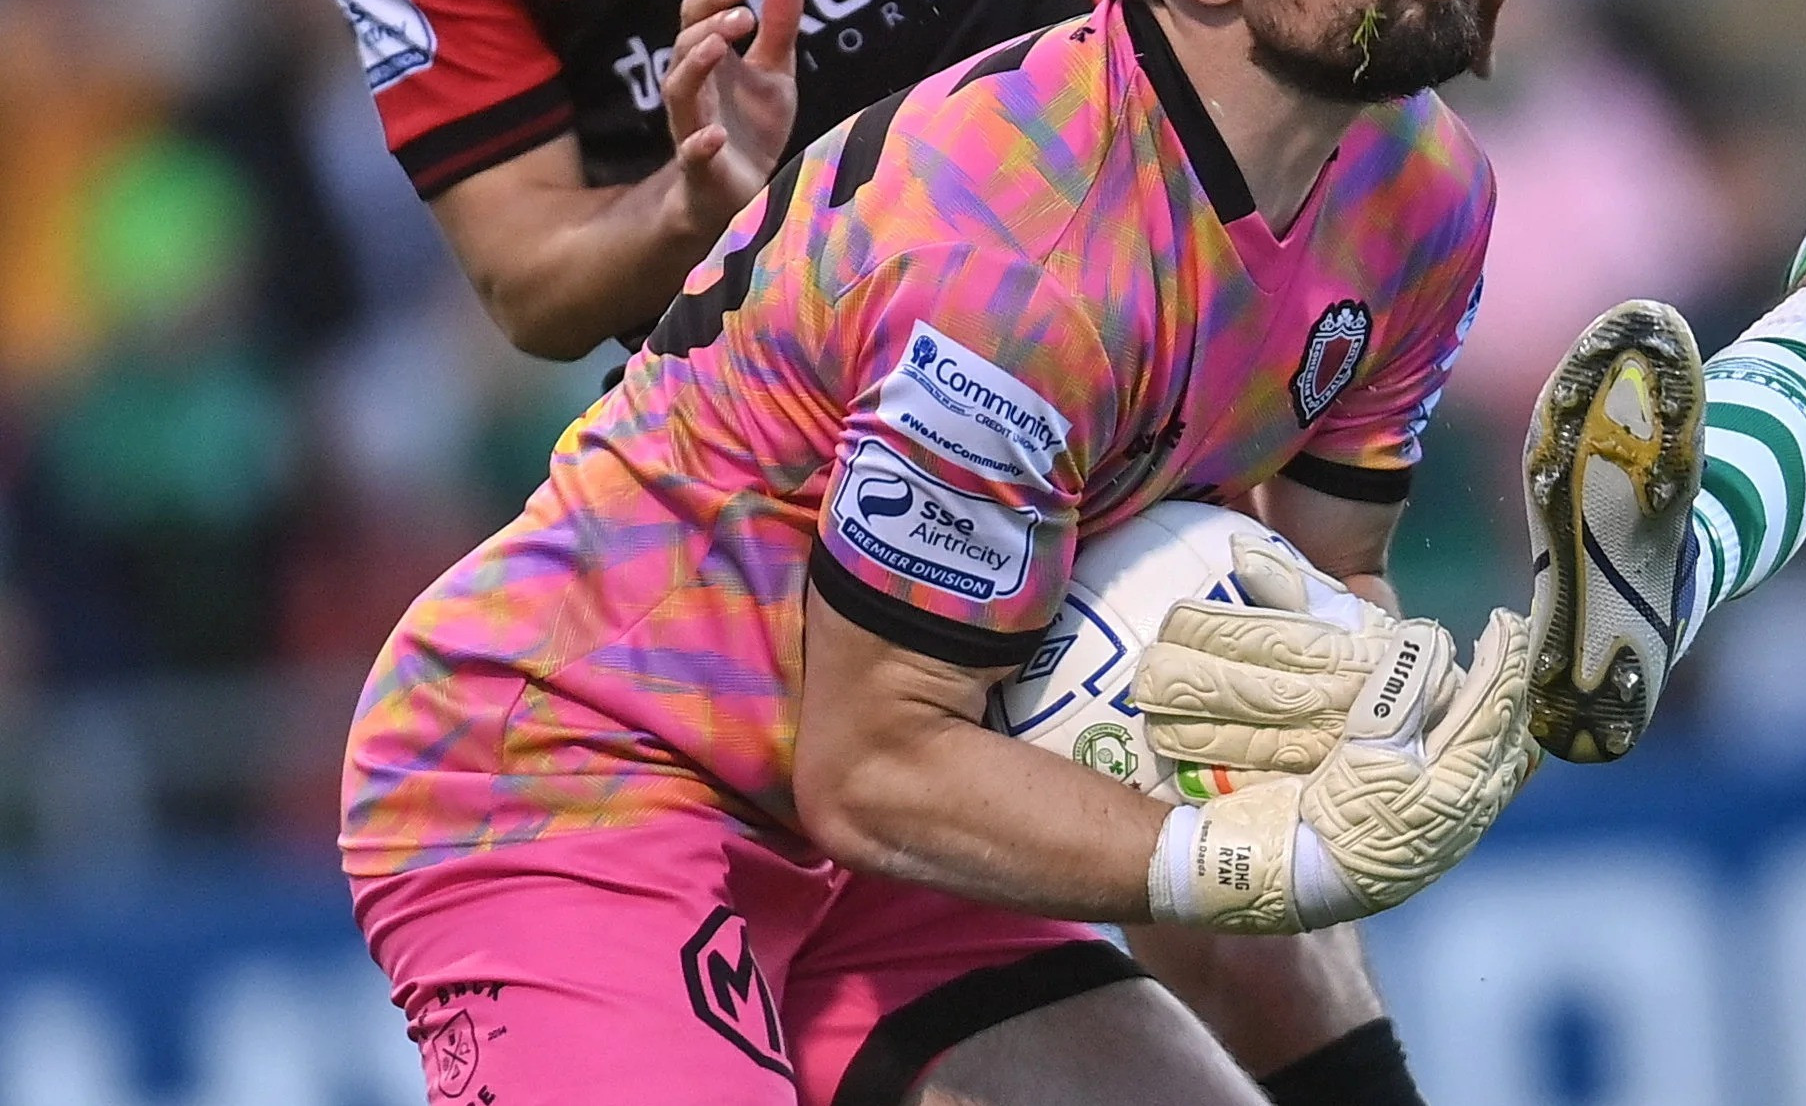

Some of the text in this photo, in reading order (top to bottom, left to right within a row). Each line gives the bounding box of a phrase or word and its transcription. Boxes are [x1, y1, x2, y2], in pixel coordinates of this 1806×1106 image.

[936, 357, 1062, 451] Community
[975, 412, 1012, 439] CREDIT
[900, 412, 1025, 477] #WeAreCommunity
[919, 500, 975, 536] sse
[846, 523, 989, 595] PREMIER DIVISION
[908, 522, 1012, 572] Airtricity
[1218, 847, 1234, 886] RYAN
